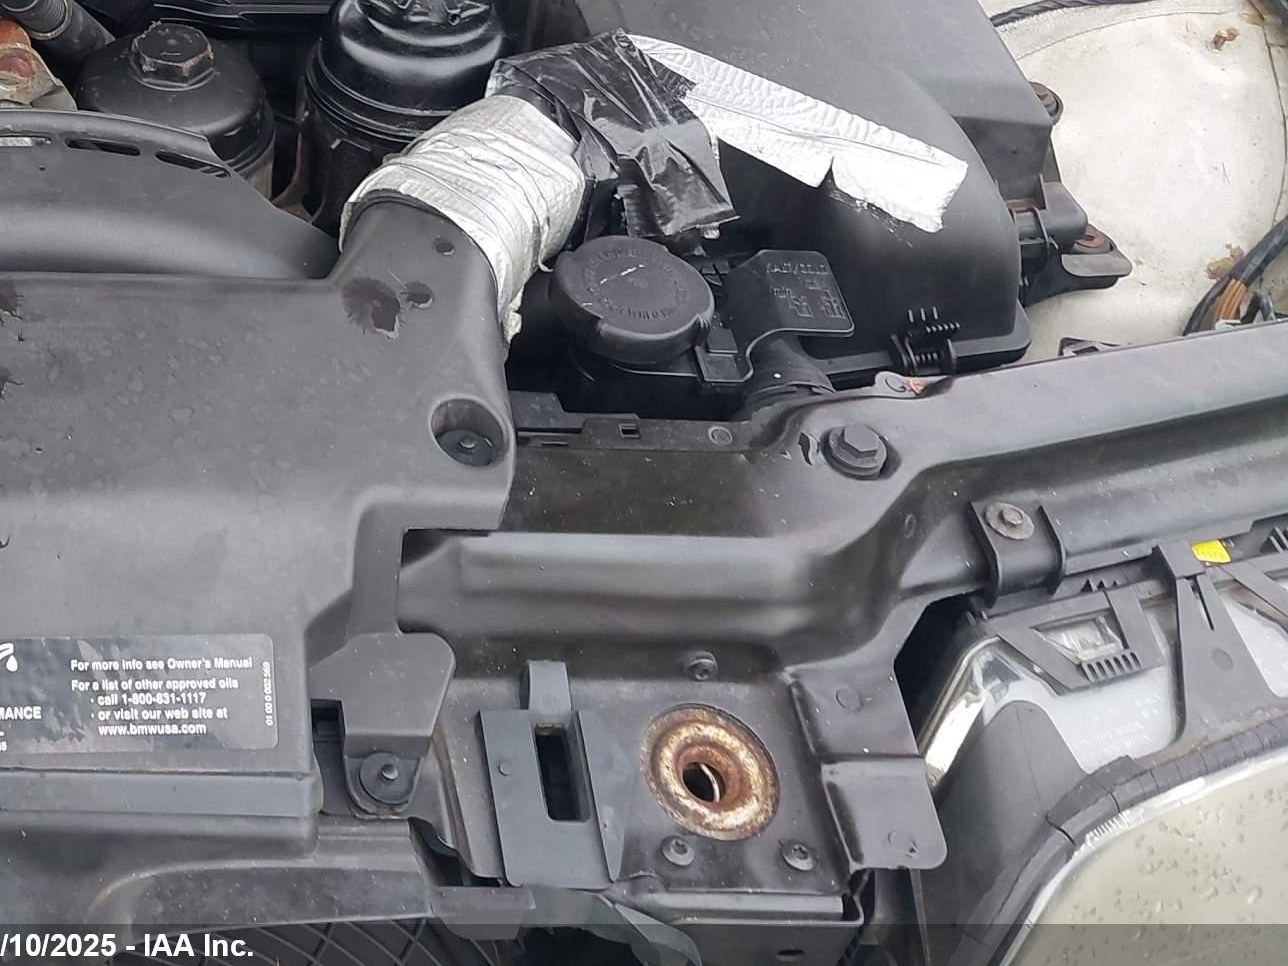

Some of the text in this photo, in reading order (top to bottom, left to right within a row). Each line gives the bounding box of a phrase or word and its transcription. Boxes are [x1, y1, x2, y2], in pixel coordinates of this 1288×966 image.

[70, 656, 253, 671] For more info see Owner's Manual
[71, 676, 239, 692] For a list of other approved oils
[97, 691, 207, 706] call 1-800-831-1117
[97, 707, 228, 721] or visit our web site at
[97, 723, 207, 736] www.bmwusa.com
